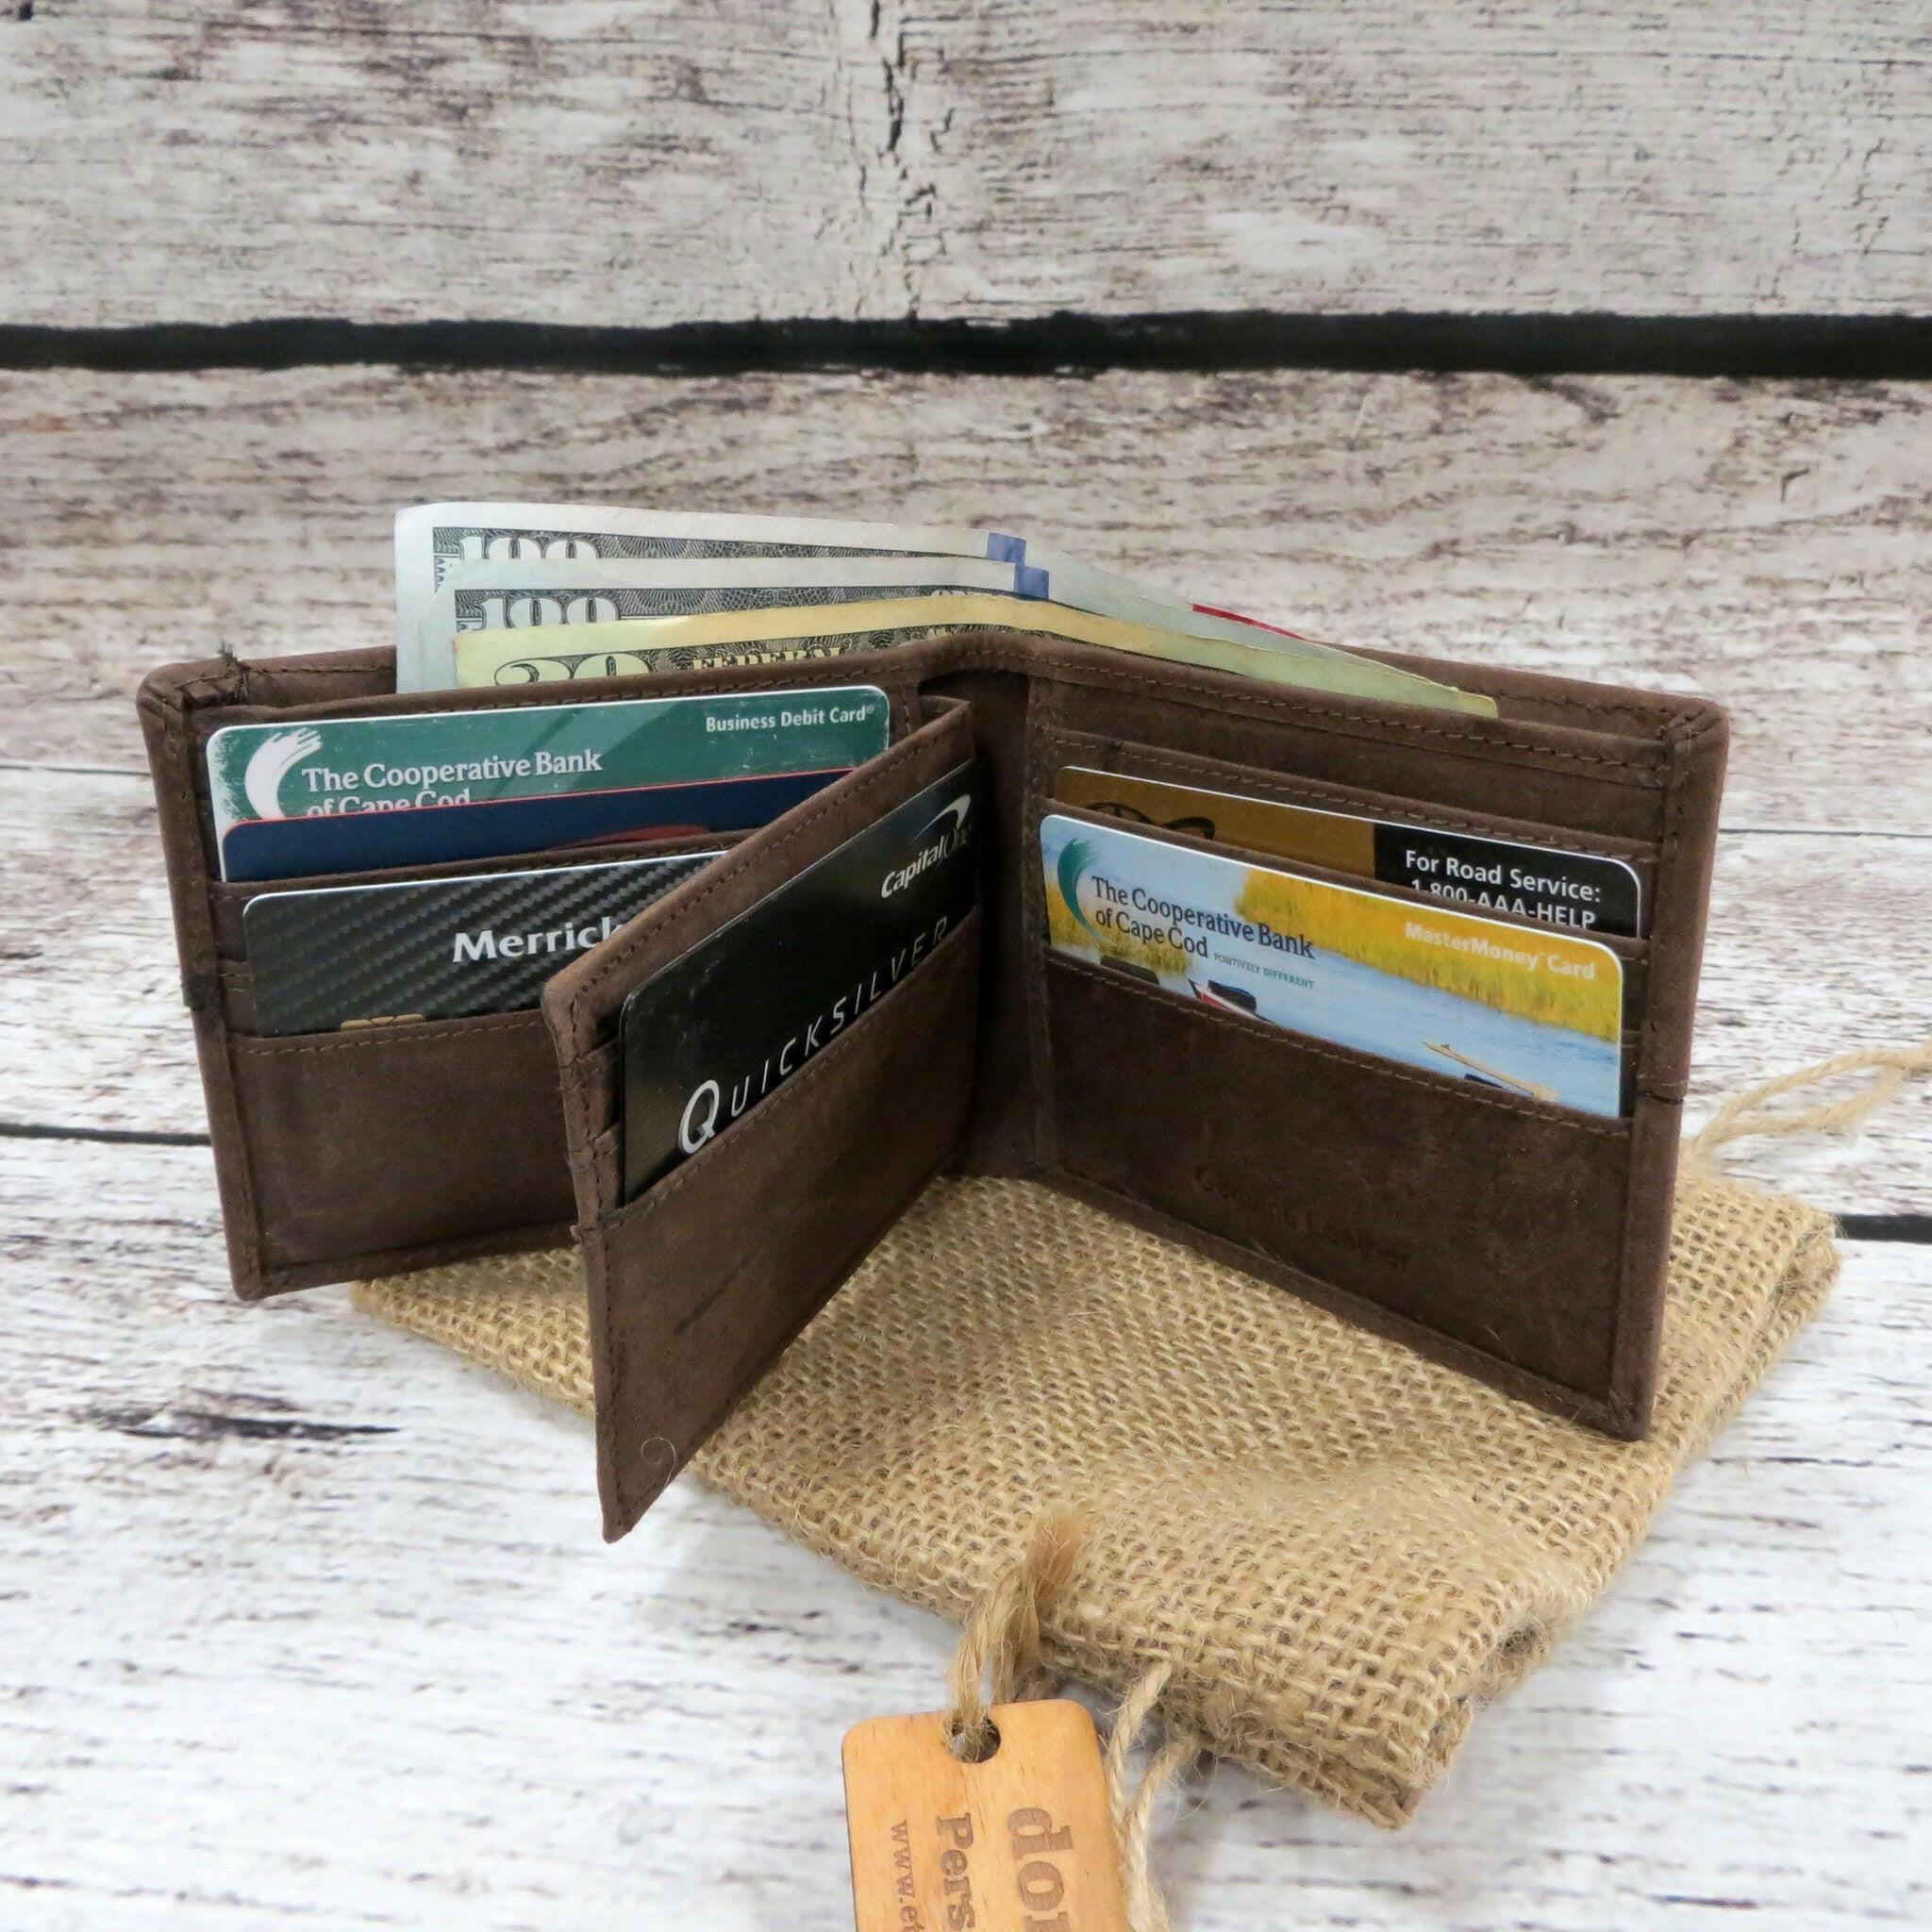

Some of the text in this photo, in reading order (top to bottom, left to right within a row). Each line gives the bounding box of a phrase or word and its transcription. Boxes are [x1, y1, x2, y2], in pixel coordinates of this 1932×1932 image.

[706, 714, 776, 733] Business
[780, 710, 824, 727] Debit
[301, 748, 603, 792] The Cooperative Bank
[414, 788, 471, 808] Cod
[1406, 849, 1602, 903] For Road Service:
[1091, 875, 1315, 959] The Cooperative Bank
[1095, 908, 1208, 958] of Cape Cod
[1262, 966, 1315, 989] DIFFERENT
[1546, 953, 1596, 980] Card
